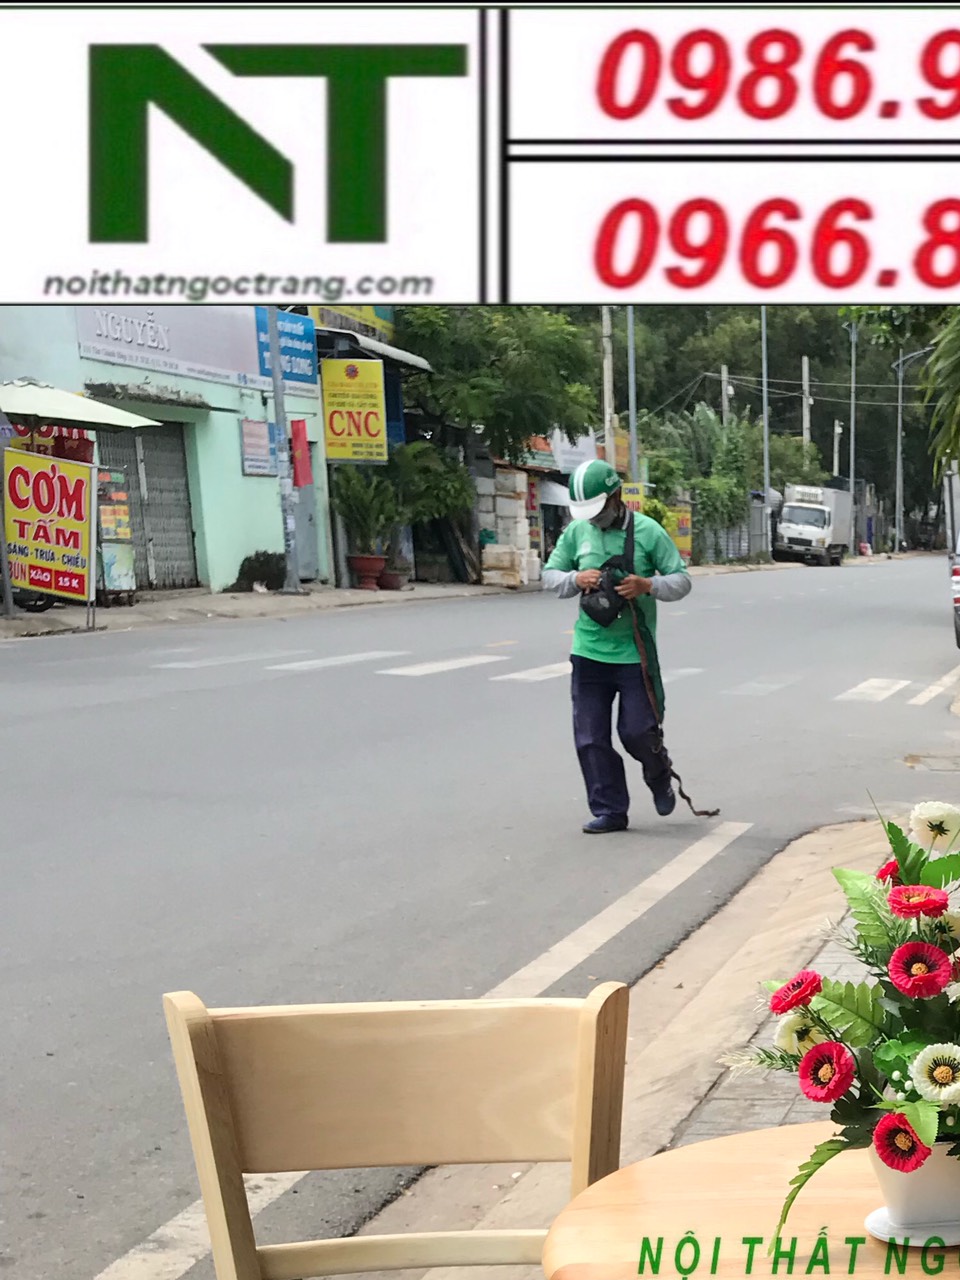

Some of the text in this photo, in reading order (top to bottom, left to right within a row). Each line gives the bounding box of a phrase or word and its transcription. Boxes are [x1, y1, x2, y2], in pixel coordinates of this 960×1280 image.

[329, 410, 381, 437] CNC
[8, 464, 86, 522] CƠM
[13, 518, 81, 550] TẤM
